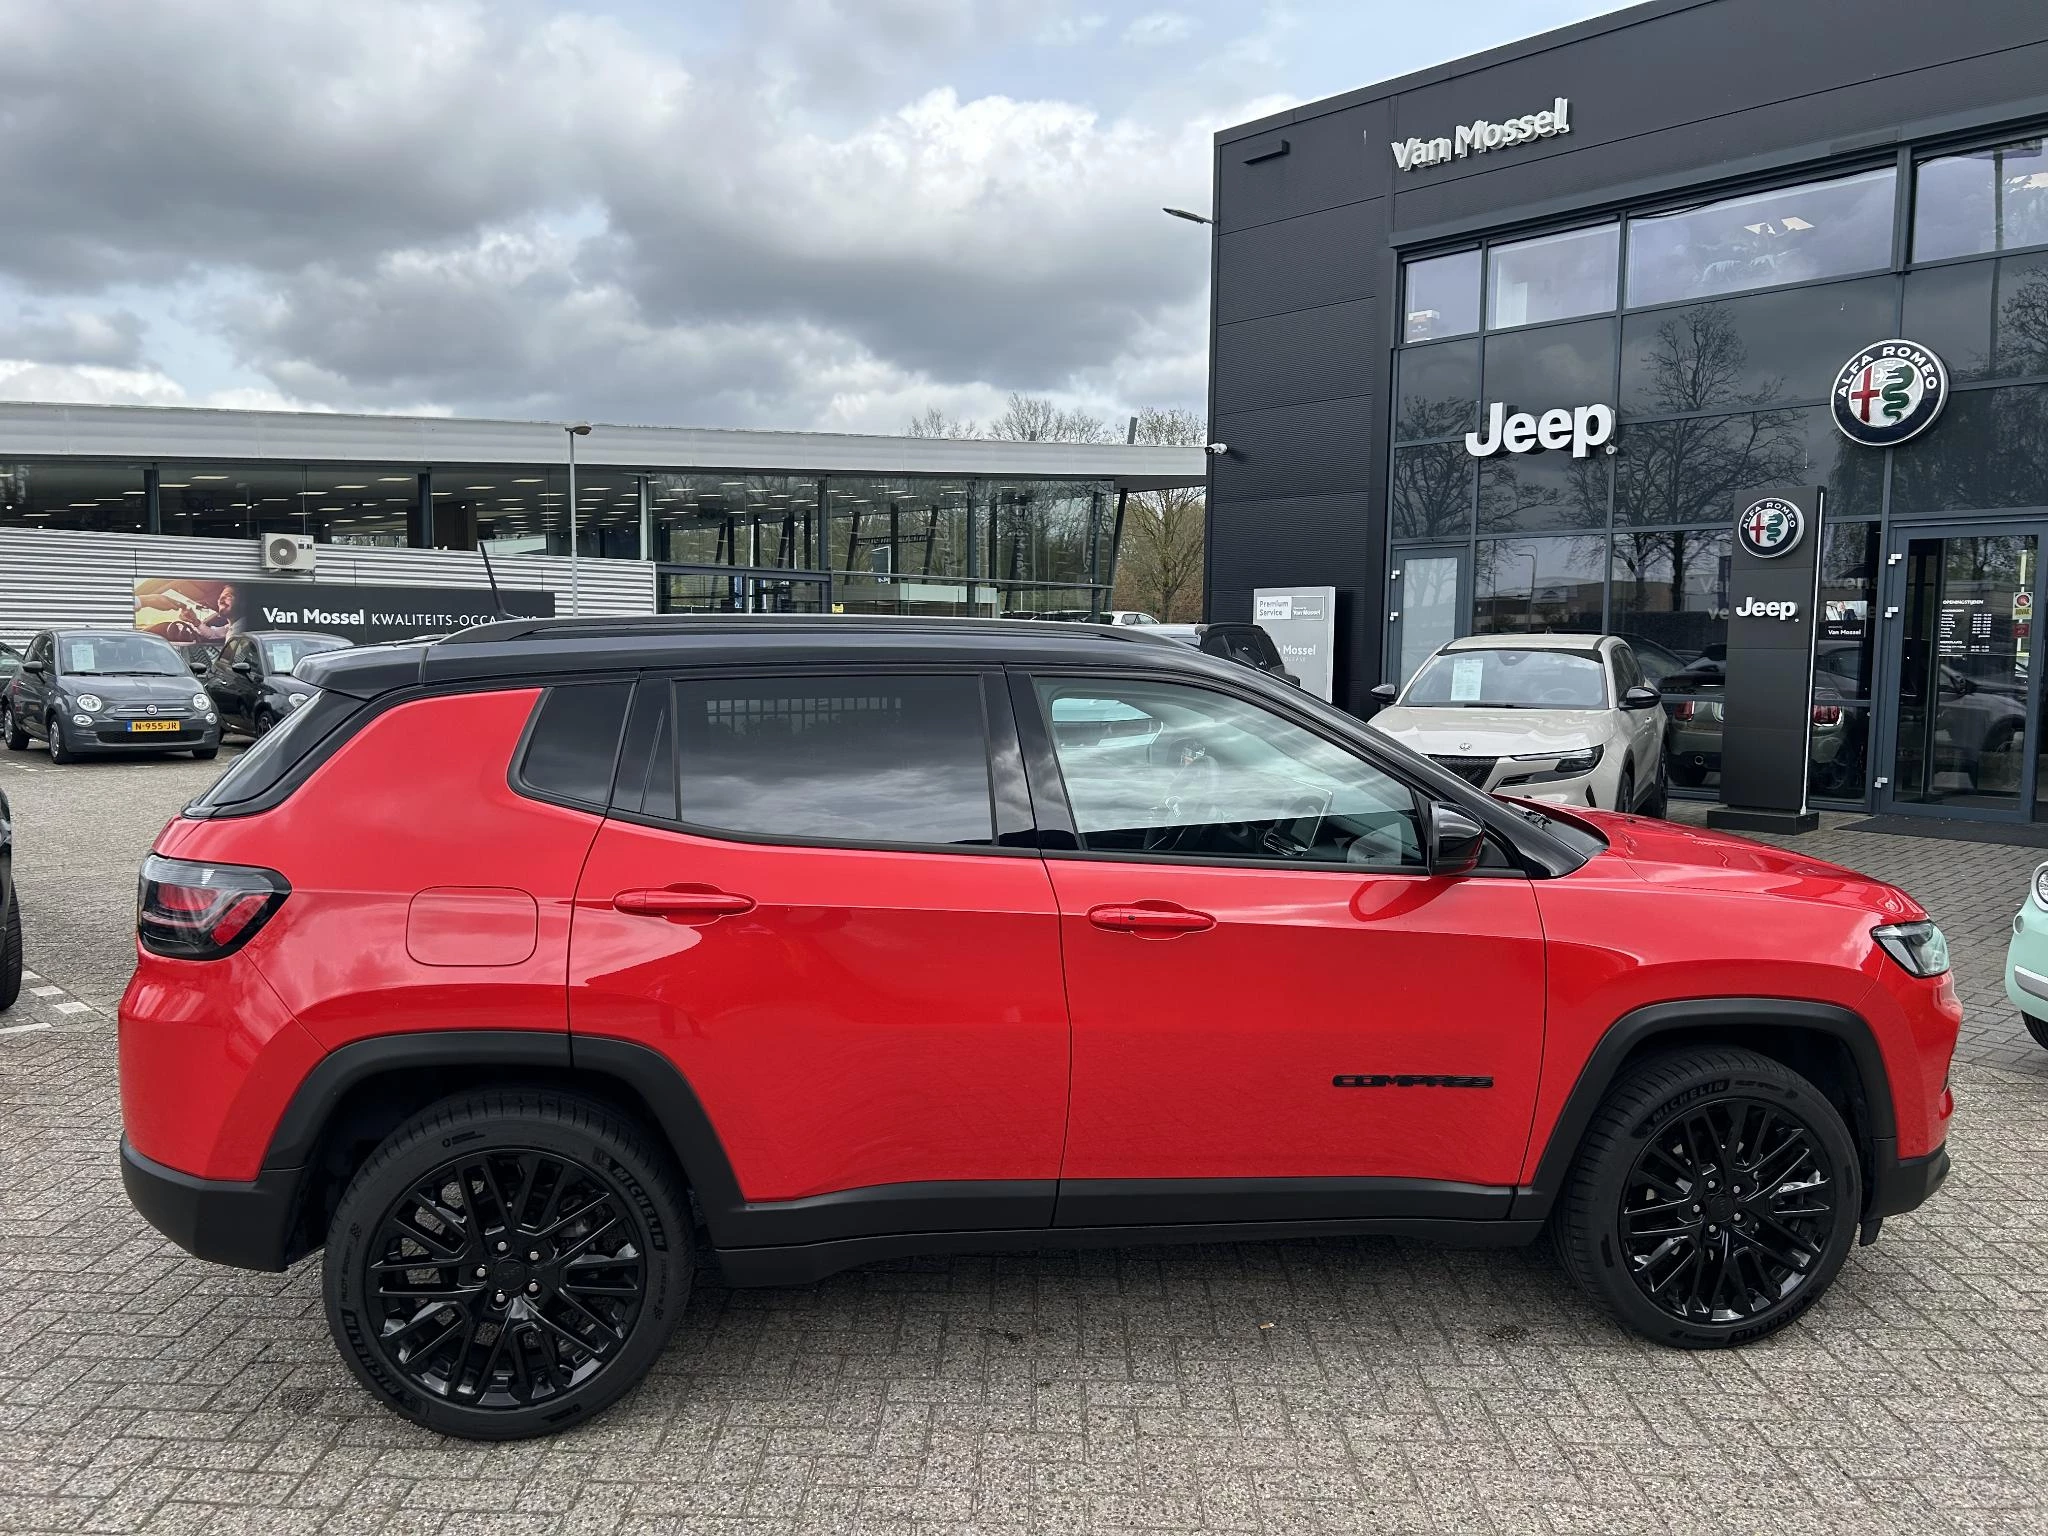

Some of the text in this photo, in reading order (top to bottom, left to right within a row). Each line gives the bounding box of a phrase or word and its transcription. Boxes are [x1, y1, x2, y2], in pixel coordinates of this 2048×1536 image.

[1390, 97, 1570, 171] Van Mossel
[1837, 346, 1938, 398] ALFA ROMEO
[1465, 401, 1617, 458] Jeep
[1742, 502, 1796, 529] ALFA ROMEO
[1259, 600, 1289, 608] Premium
[1259, 609, 1283, 617] Service
[1735, 597, 1798, 621] Jeep
[262, 607, 537, 626] Van Mossel KWALITEITS-OCCA
[1282, 644, 1316, 656] Mossel
[135, 722, 177, 731] N-955-JR
[1332, 1075, 1494, 1089] COMPASS
[1652, 1080, 1726, 1123] MICHELIN
[612, 1166, 667, 1248] MICHELIN
